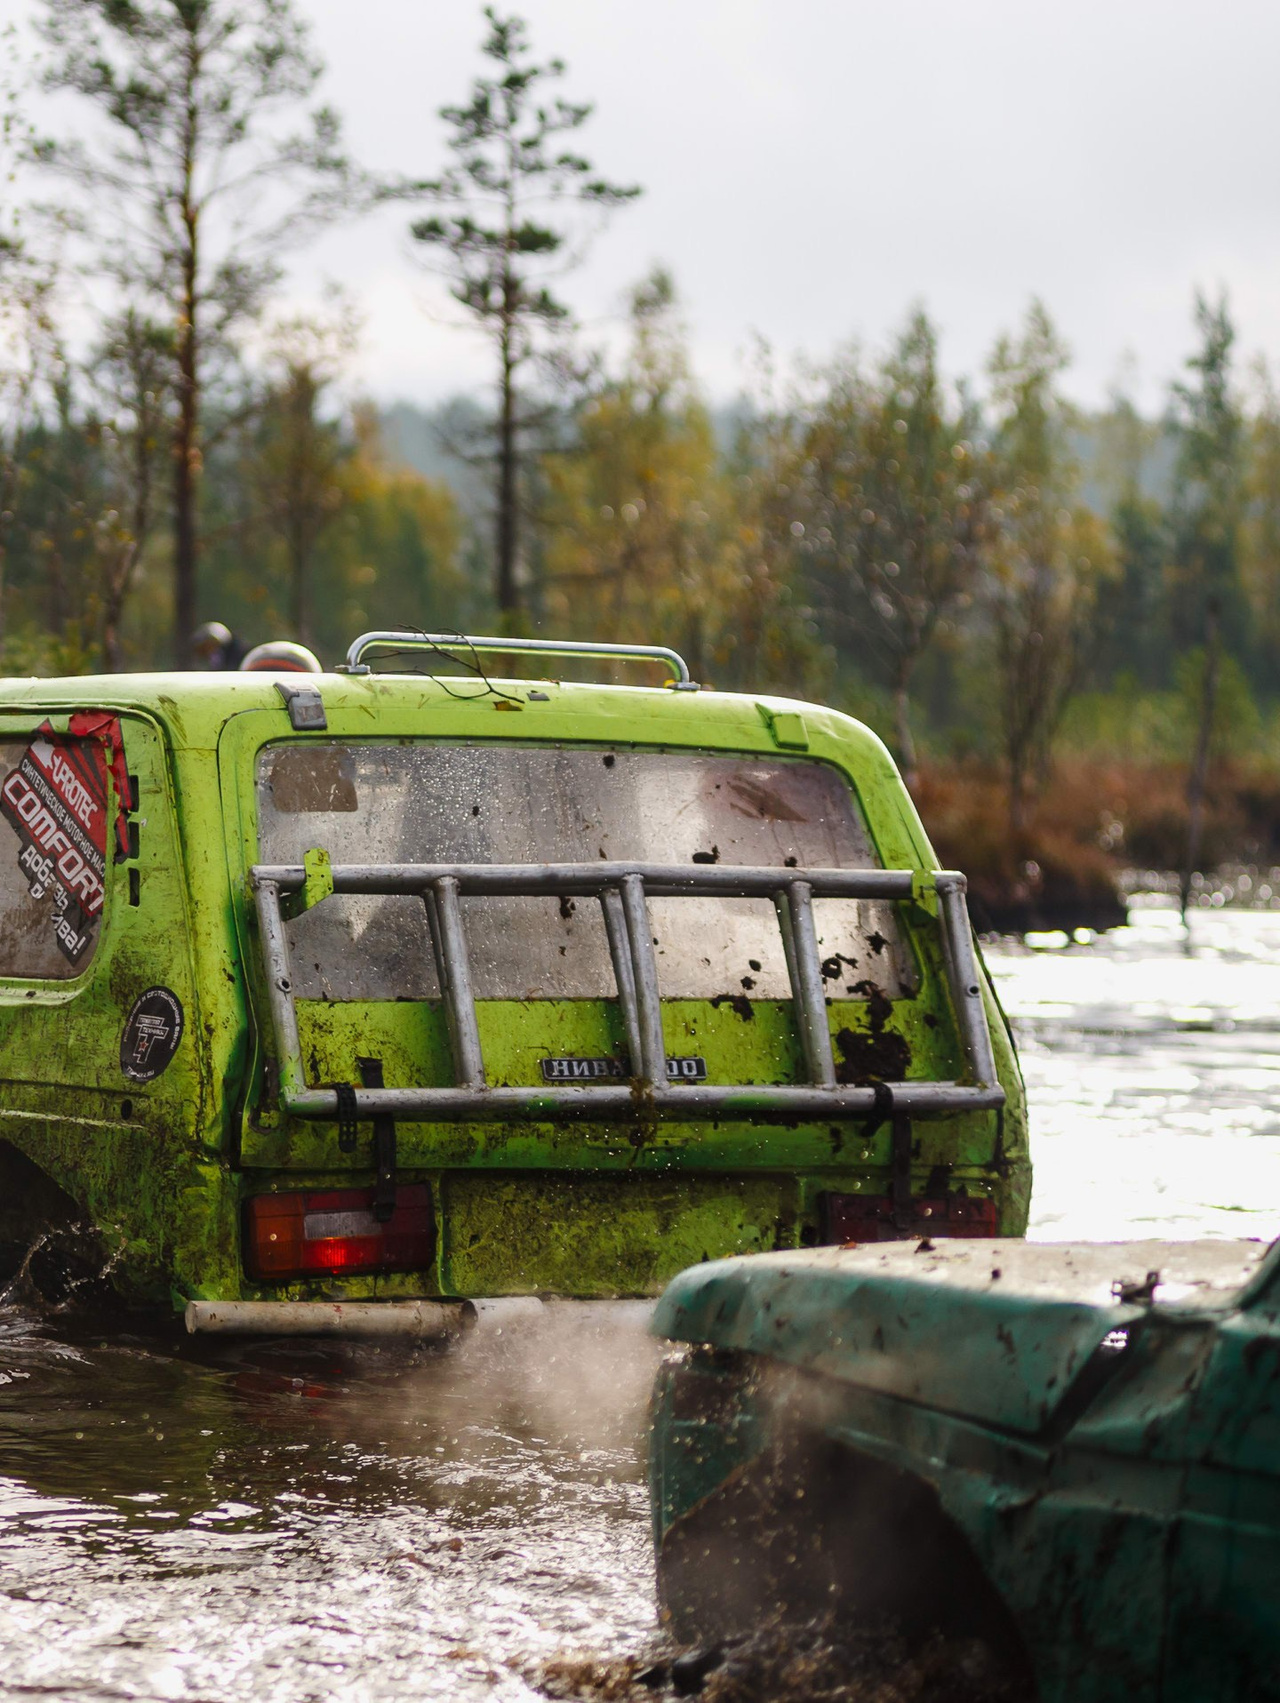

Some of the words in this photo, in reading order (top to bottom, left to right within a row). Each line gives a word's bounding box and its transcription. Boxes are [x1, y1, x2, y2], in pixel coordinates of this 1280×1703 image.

[5, 773, 105, 912] COMFORT
[22, 758, 65, 826] СИНТЕТИЧЕСКОЕ
[63, 816, 95, 859] МОТОРНОЕ
